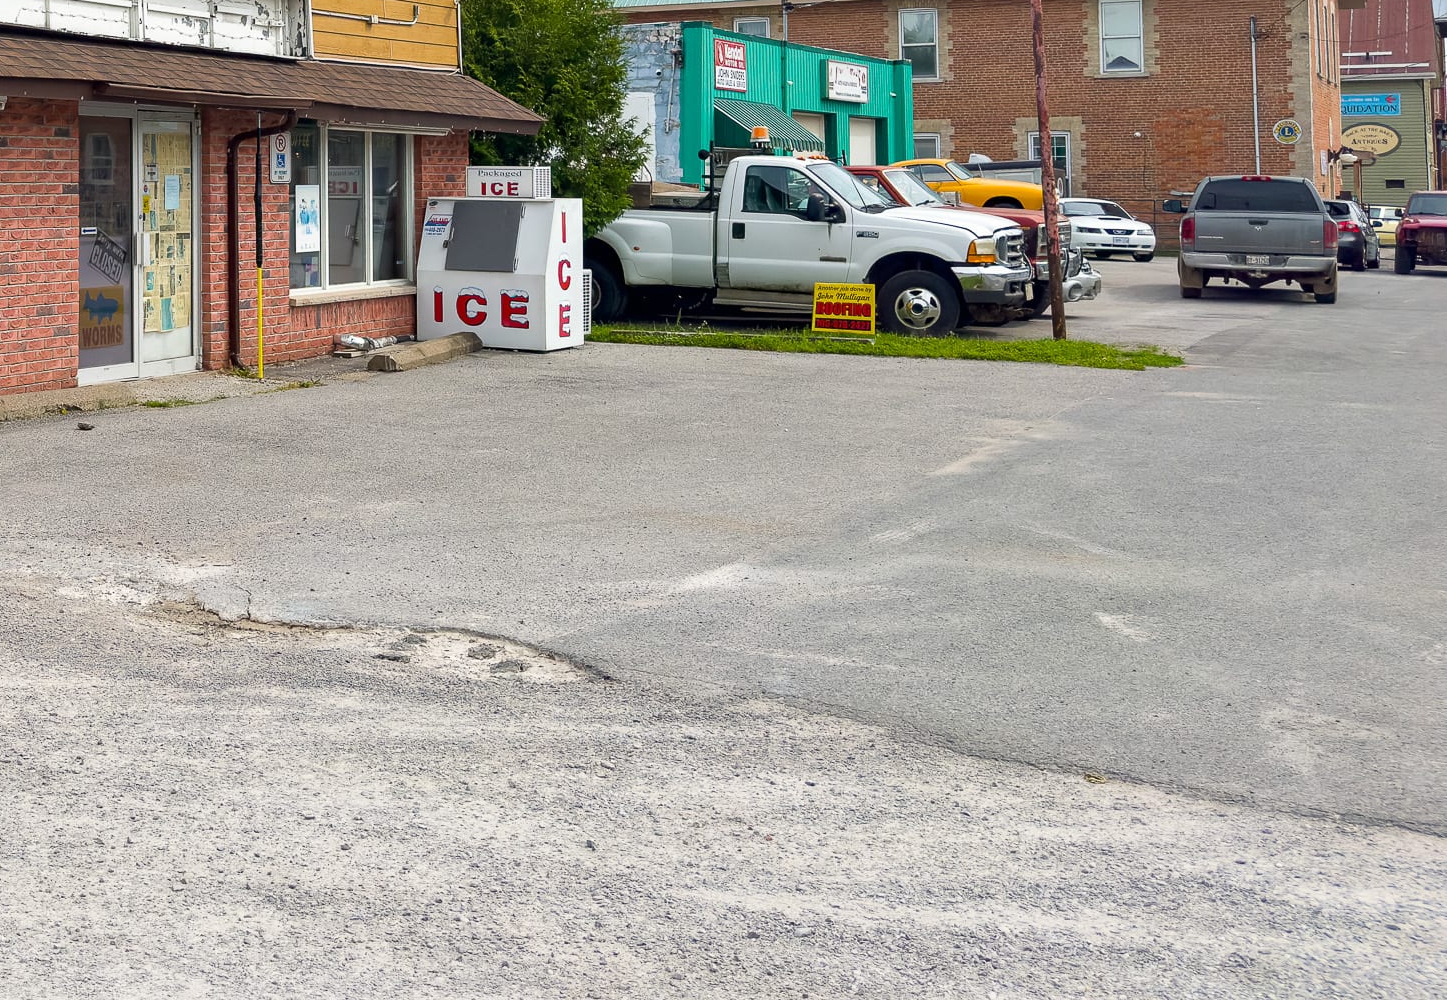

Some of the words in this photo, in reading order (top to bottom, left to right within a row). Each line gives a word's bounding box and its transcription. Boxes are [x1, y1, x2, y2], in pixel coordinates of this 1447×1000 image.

[724, 43, 744, 61] Kendall
[718, 68, 730, 78] JOHN
[477, 169, 522, 178] Packaged
[481, 181, 519, 196] ICE
[91, 244, 123, 282] CLOSED
[557, 210, 572, 338] ICE
[816, 292, 834, 301] John
[836, 293, 870, 302] Mulligan
[433, 285, 530, 330] ICE
[816, 302, 871, 317] ROOFING
[81, 325, 123, 348] WORMS
